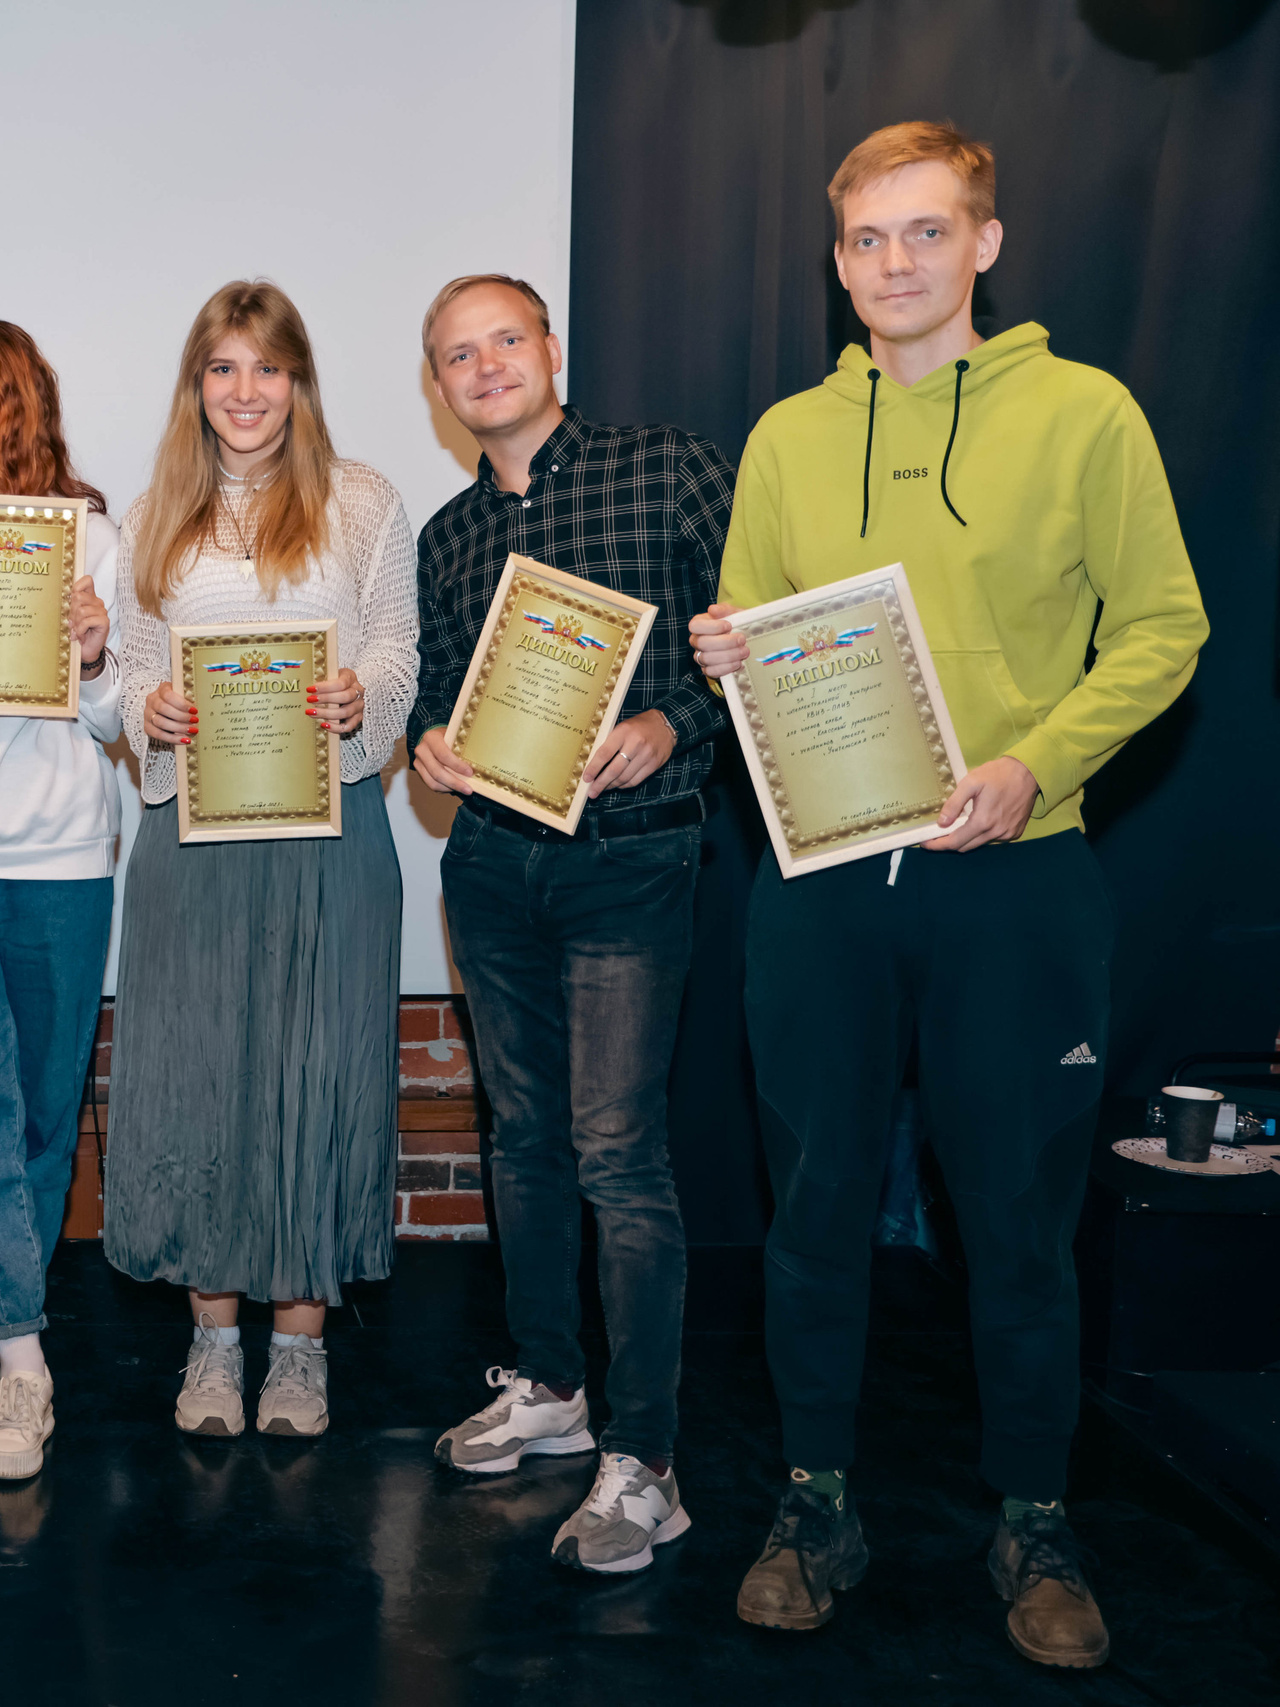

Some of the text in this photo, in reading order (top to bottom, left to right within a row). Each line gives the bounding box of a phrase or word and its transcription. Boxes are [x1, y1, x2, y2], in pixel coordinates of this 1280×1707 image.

[893, 468, 928, 480] BOSS
[516, 633, 598, 676] ДИПЛОМ
[773, 648, 882, 697] ДИПЛОМ
[210, 679, 300, 698] ДИПЛОМ
[828, 684, 847, 693] место
[1060, 1055, 1097, 1065] adidas
